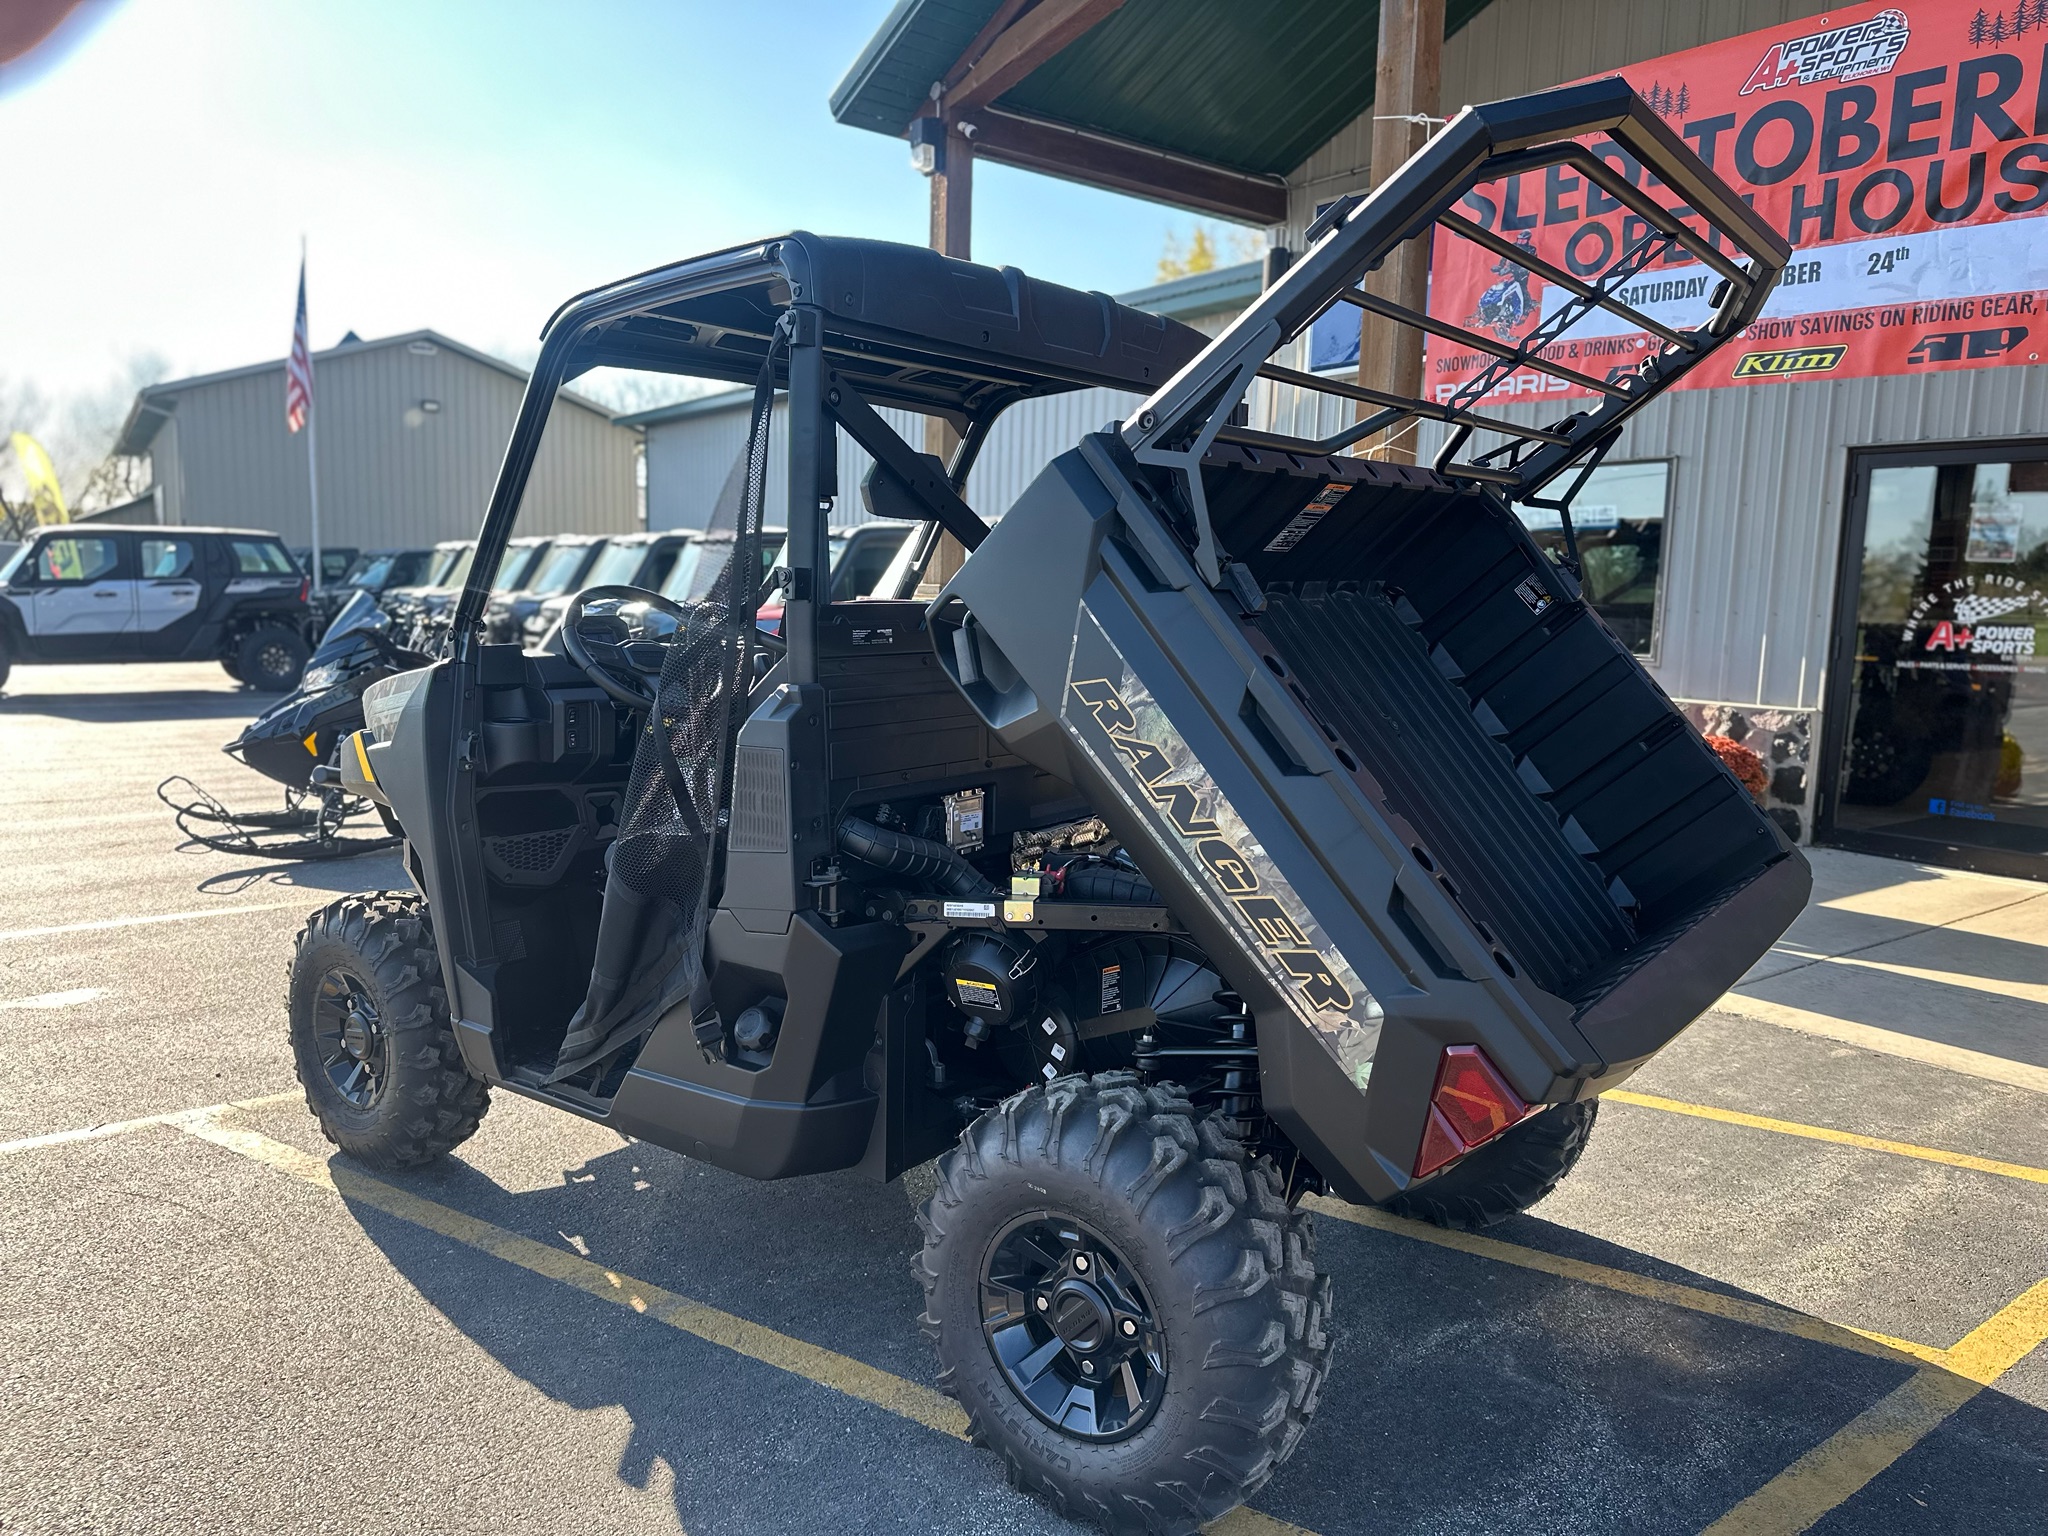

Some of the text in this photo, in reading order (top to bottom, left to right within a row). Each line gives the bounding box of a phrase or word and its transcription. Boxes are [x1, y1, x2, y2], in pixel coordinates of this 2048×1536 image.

[1801, 74, 1811, 83] &
[1618, 276, 1709, 307] SATURDAY
[1866, 246, 1911, 276] 24th
[1538, 345, 1565, 361] OOD
[1568, 343, 1579, 359] &
[1584, 337, 1636, 358] DRINKS
[1748, 320, 1796, 341] SHOW
[1800, 311, 1875, 335] SAVINGS
[1880, 308, 1905, 328] ON
[1912, 299, 1975, 324] RIDING
[1981, 293, 2038, 318] GEAR,
[1902, 593, 1938, 642] WHERE
[1942, 575, 1975, 594] THE
[1985, 574, 2026, 592] RIDE
[1925, 620, 1975, 651] A+
[1975, 626, 2035, 641] POWER
[1971, 640, 2035, 654] SPORTS
[1070, 677, 1354, 1012] RANGER
[976, 1380, 1072, 1473] CARLSTAR
